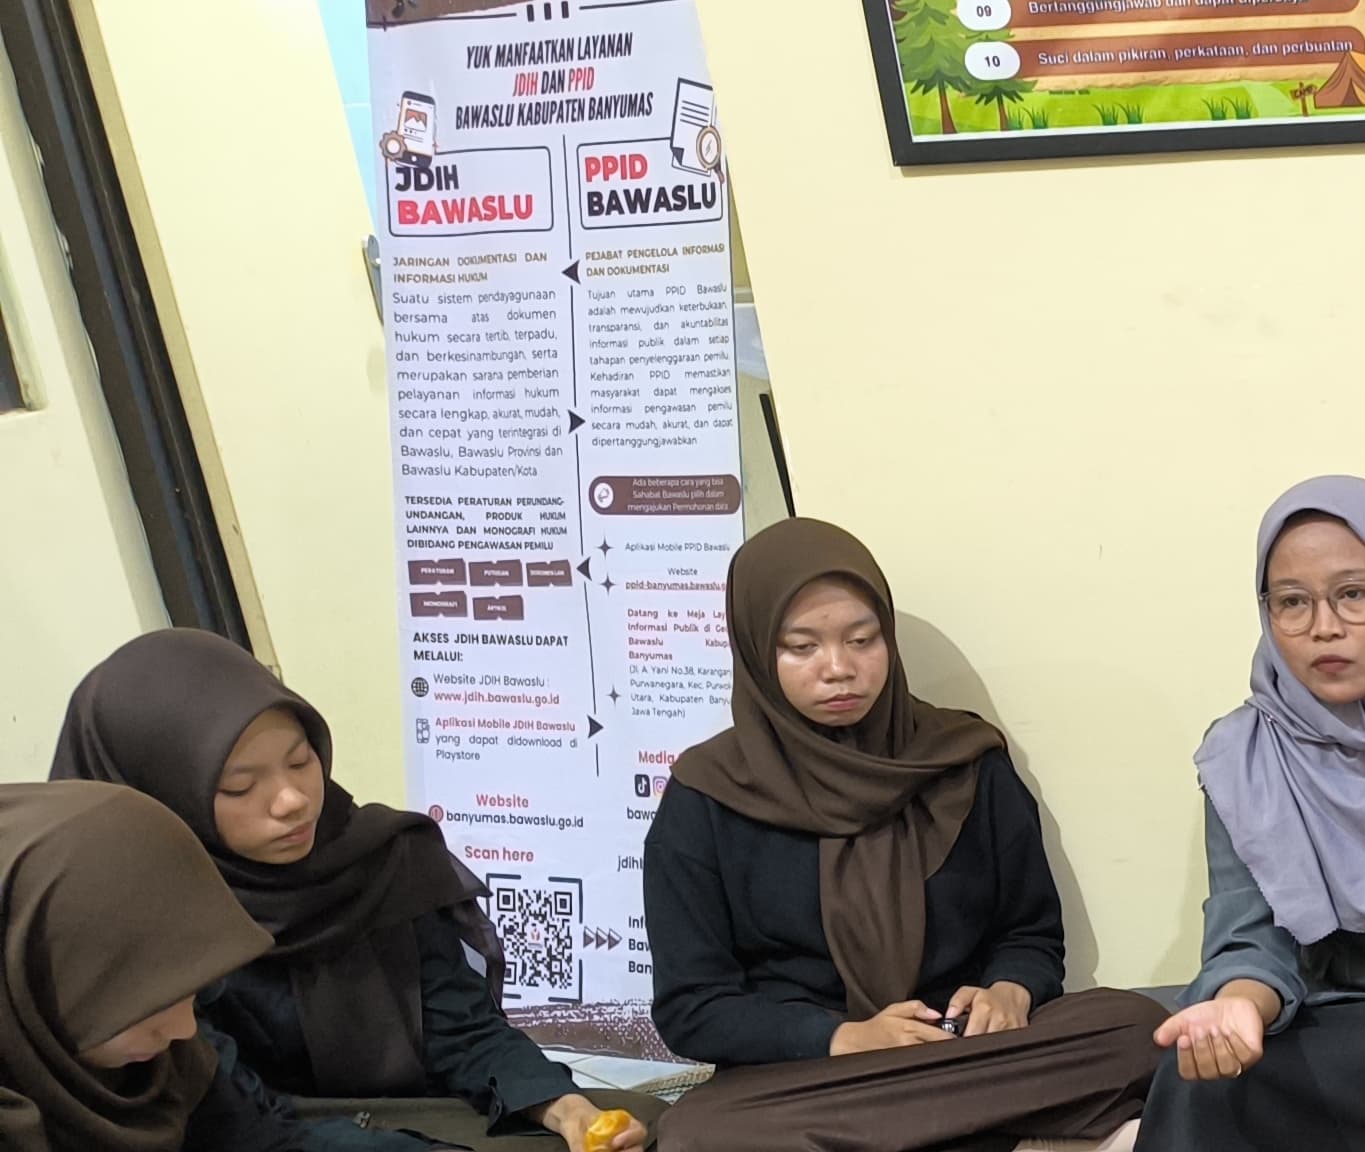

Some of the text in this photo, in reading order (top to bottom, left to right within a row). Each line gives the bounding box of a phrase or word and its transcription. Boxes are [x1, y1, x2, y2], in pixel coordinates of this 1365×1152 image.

[977, 5, 992, 17] 09
[466, 33, 633, 69] YUK MANFAATKAN LAYANAN
[1039, 53, 1069, 65] Suci
[1073, 51, 1114, 63] dalam
[1119, 48, 1170, 63] pikiran,
[1253, 43, 1278, 56] dan
[1283, 40, 1353, 56] perbuatan
[985, 56, 1000, 67] 10
[513, 67, 594, 97] JDIH DAN PPID
[456, 92, 653, 130] BAWASLU KABUPATEN BANYUMAS
[585, 154, 648, 182] PPID
[395, 165, 459, 191] JDIH
[587, 182, 716, 217] BAWASLU
[397, 195, 532, 224] BAWASLU
[586, 243, 725, 260] PEJABAT PENGELOLA INFORMASI
[393, 253, 547, 266] JARINGAN DOKUMENTASI DAN
[587, 264, 669, 276] DAN DOKUMENTASI
[394, 272, 488, 283] INFORMASI HUKUM
[393, 290, 555, 304] Suatu sistem pendayagunaan
[588, 284, 727, 301] Tujuan utama PPID Bawaslu
[394, 310, 557, 323] bersama atas dokumen
[588, 304, 675, 316] adalah mewujudkan
[654, 321, 669, 329] dan
[395, 329, 558, 343] hukum secara terpadu,
[590, 335, 699, 348] informasi publik dalam
[396, 349, 558, 361] dan serta
[590, 354, 700, 367] tahapan penyelenggaraan
[397, 368, 558, 382] merupakan sarana pemberian
[591, 369, 731, 381] Kehadiran PPID memastikan
[398, 389, 559, 402] pelayanan informasi hukum
[591, 388, 677, 399] masyarakat dapat
[398, 407, 560, 422] secara lengkap, mudah,
[591, 402, 732, 414] informasi pengawasan pemilu
[592, 419, 709, 430] secara dan
[400, 426, 562, 441] dan cepat yang terintegrasi di
[592, 436, 697, 448] dipertanggungjawabkan
[401, 445, 562, 458] Bawaslu, Bawaslu Provinsi dan
[402, 464, 537, 478] Bawaslu Kabupaten/Kota
[405, 496, 512, 506] TERSEDIA PERATURAN
[406, 511, 566, 521] UNDANGAN, PRODUK HUKUM
[407, 525, 567, 535] LAINNYA DAN MONOGRAFI HUKUM
[407, 540, 553, 550] DIBIDANG PENGAWASAN PEMILU
[658, 543, 683, 552] Mobile
[685, 543, 702, 551] PPID
[668, 567, 697, 576] Website
[628, 609, 705, 620] Datang ke Meja
[628, 624, 711, 632] Informasi Publik di
[413, 633, 568, 646] AKSES JDIH BAWASLU DAPAT
[629, 638, 664, 646] Bawaslu
[414, 650, 463, 662] MELALUI:
[629, 652, 673, 661] Banyumas
[433, 674, 545, 687] Website JDIH Bawaslu
[434, 690, 559, 707] www.jdih.bawaslu.go.id
[660, 695, 703, 705] Kabupaten
[653, 708, 686, 718] Tengah)
[435, 718, 575, 732] Aplikasi Mobile JDIH Bawaslu
[435, 736, 577, 748] yang dapat didownload di
[436, 750, 480, 761] Playstore
[639, 751, 674, 764] Media
[476, 794, 529, 808] Website
[447, 810, 584, 830] banyumas.bawaslu.go.id
[627, 807, 657, 820] bawa
[465, 846, 534, 862] Scan here
